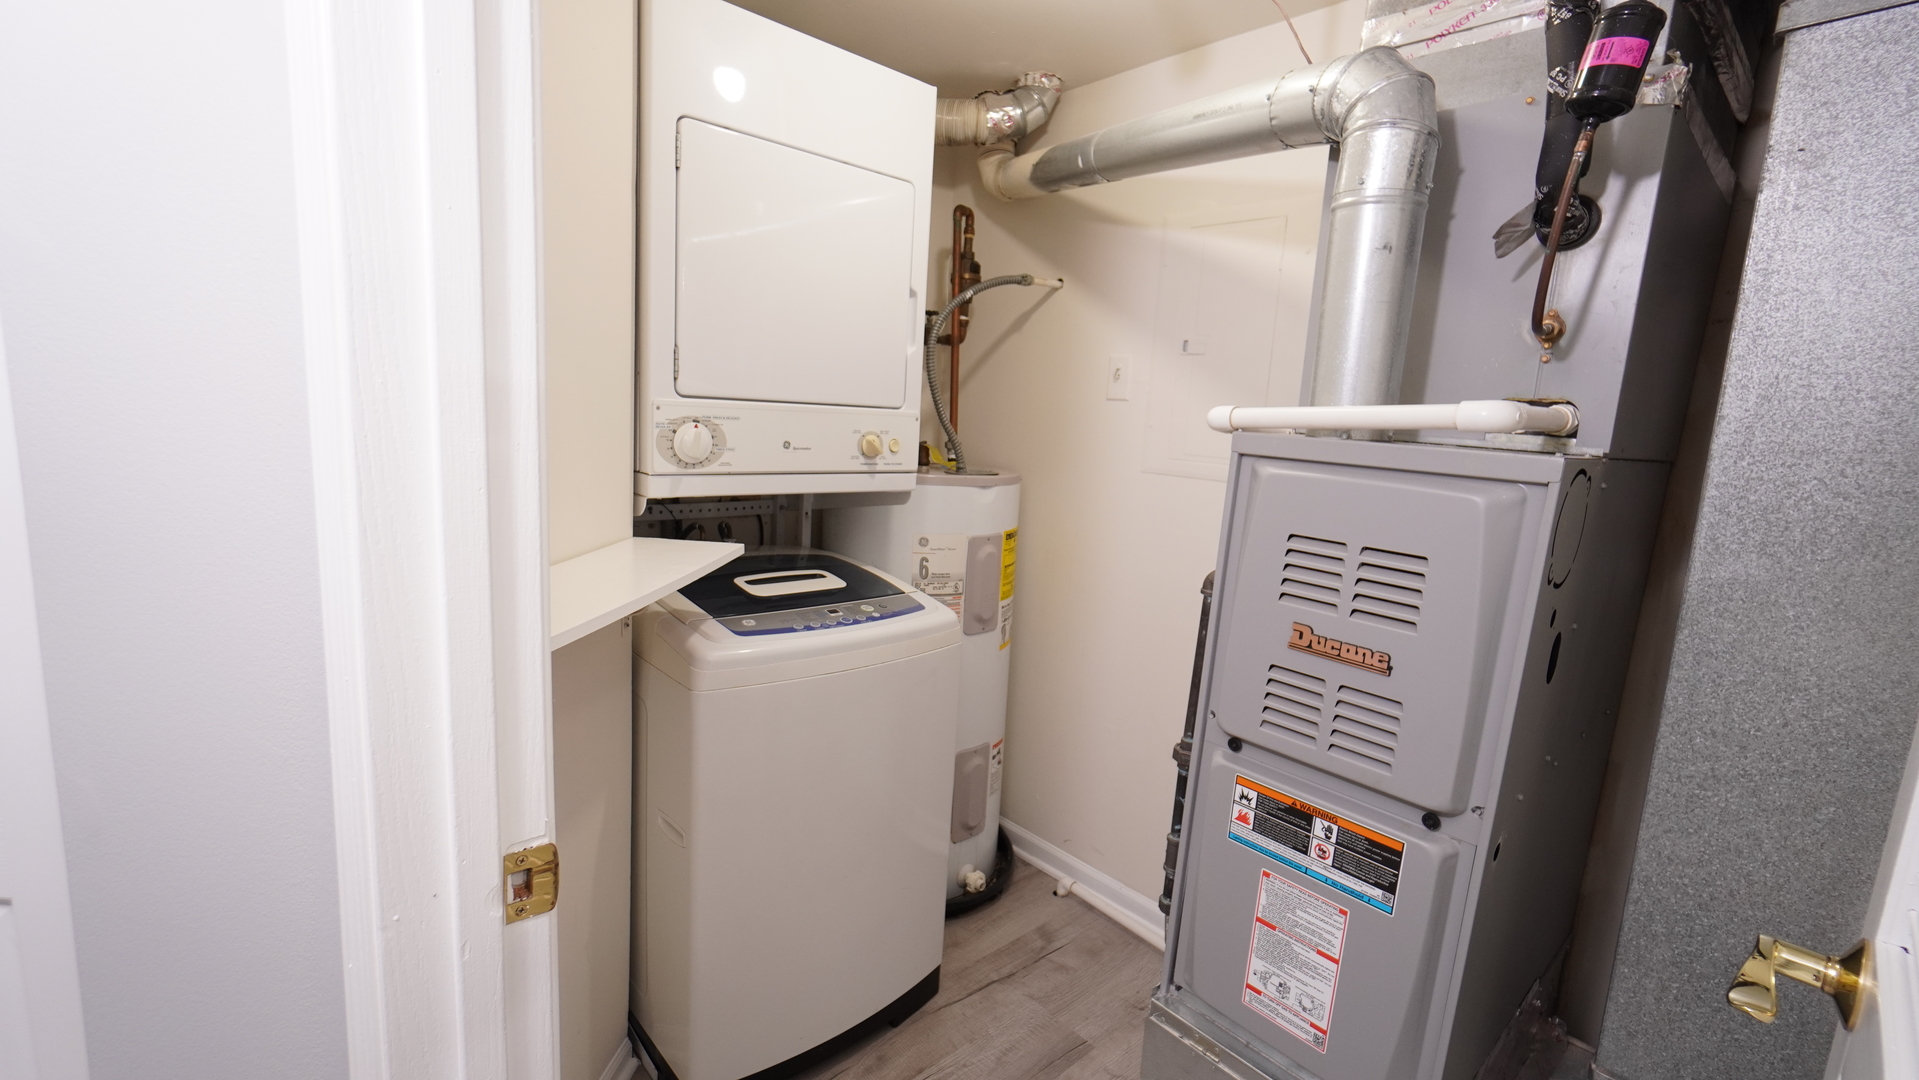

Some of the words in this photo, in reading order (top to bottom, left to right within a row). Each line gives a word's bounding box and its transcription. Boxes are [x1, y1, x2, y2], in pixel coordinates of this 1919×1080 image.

[919, 556, 930, 580] 6
[1290, 622, 1391, 670] Ducane
[1300, 802, 1338, 824] WARNING
